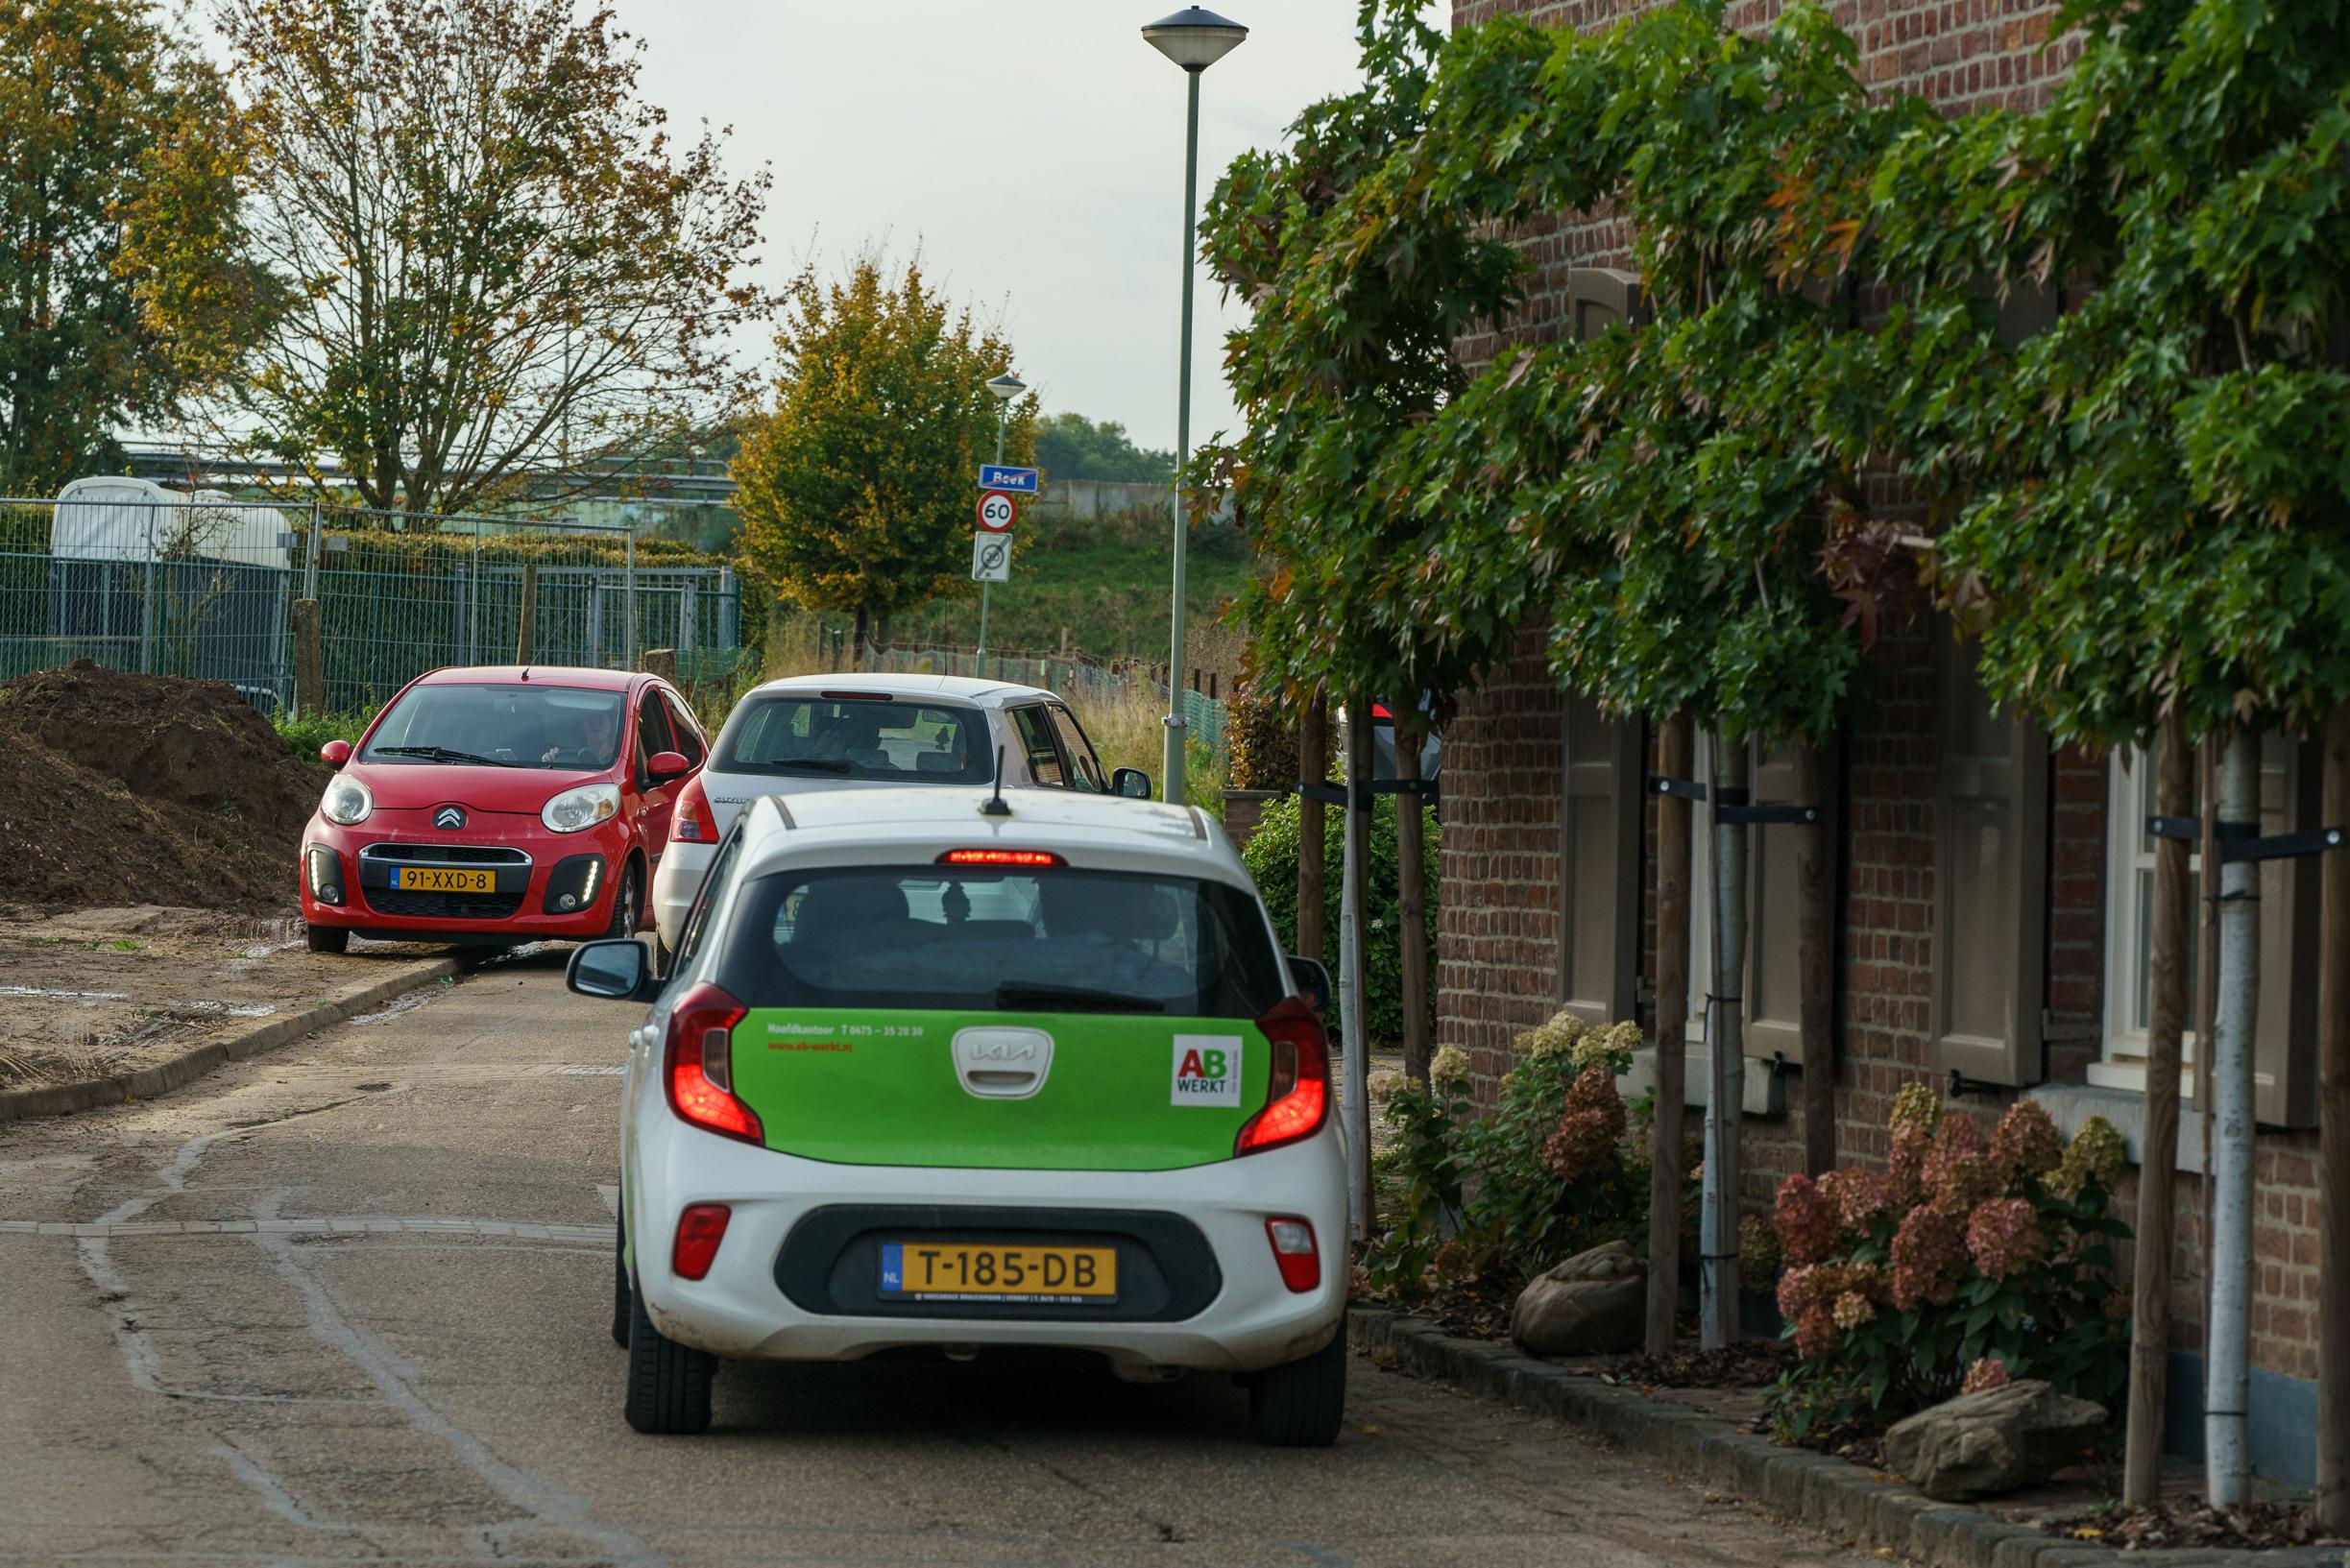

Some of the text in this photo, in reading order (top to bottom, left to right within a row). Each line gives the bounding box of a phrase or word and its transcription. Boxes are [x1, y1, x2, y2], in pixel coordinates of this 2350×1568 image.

[993, 471, 1026, 486] Beek
[984, 503, 1010, 519] 60
[406, 870, 487, 889] 91-XXD-8
[767, 1024, 834, 1035] Hoofdkantoor
[840, 1025, 848, 1035] T
[849, 1025, 872, 1036] 0475
[884, 1025, 895, 1036] 35
[911, 1026, 923, 1036] 30
[767, 1040, 853, 1052] www.ab-werkt.nl
[969, 1043, 1036, 1061] KIA
[1177, 1049, 1227, 1079] AB
[1177, 1079, 1226, 1093] WERKT
[918, 1250, 1097, 1288] T-185-DB
[884, 1272, 899, 1283] NL
